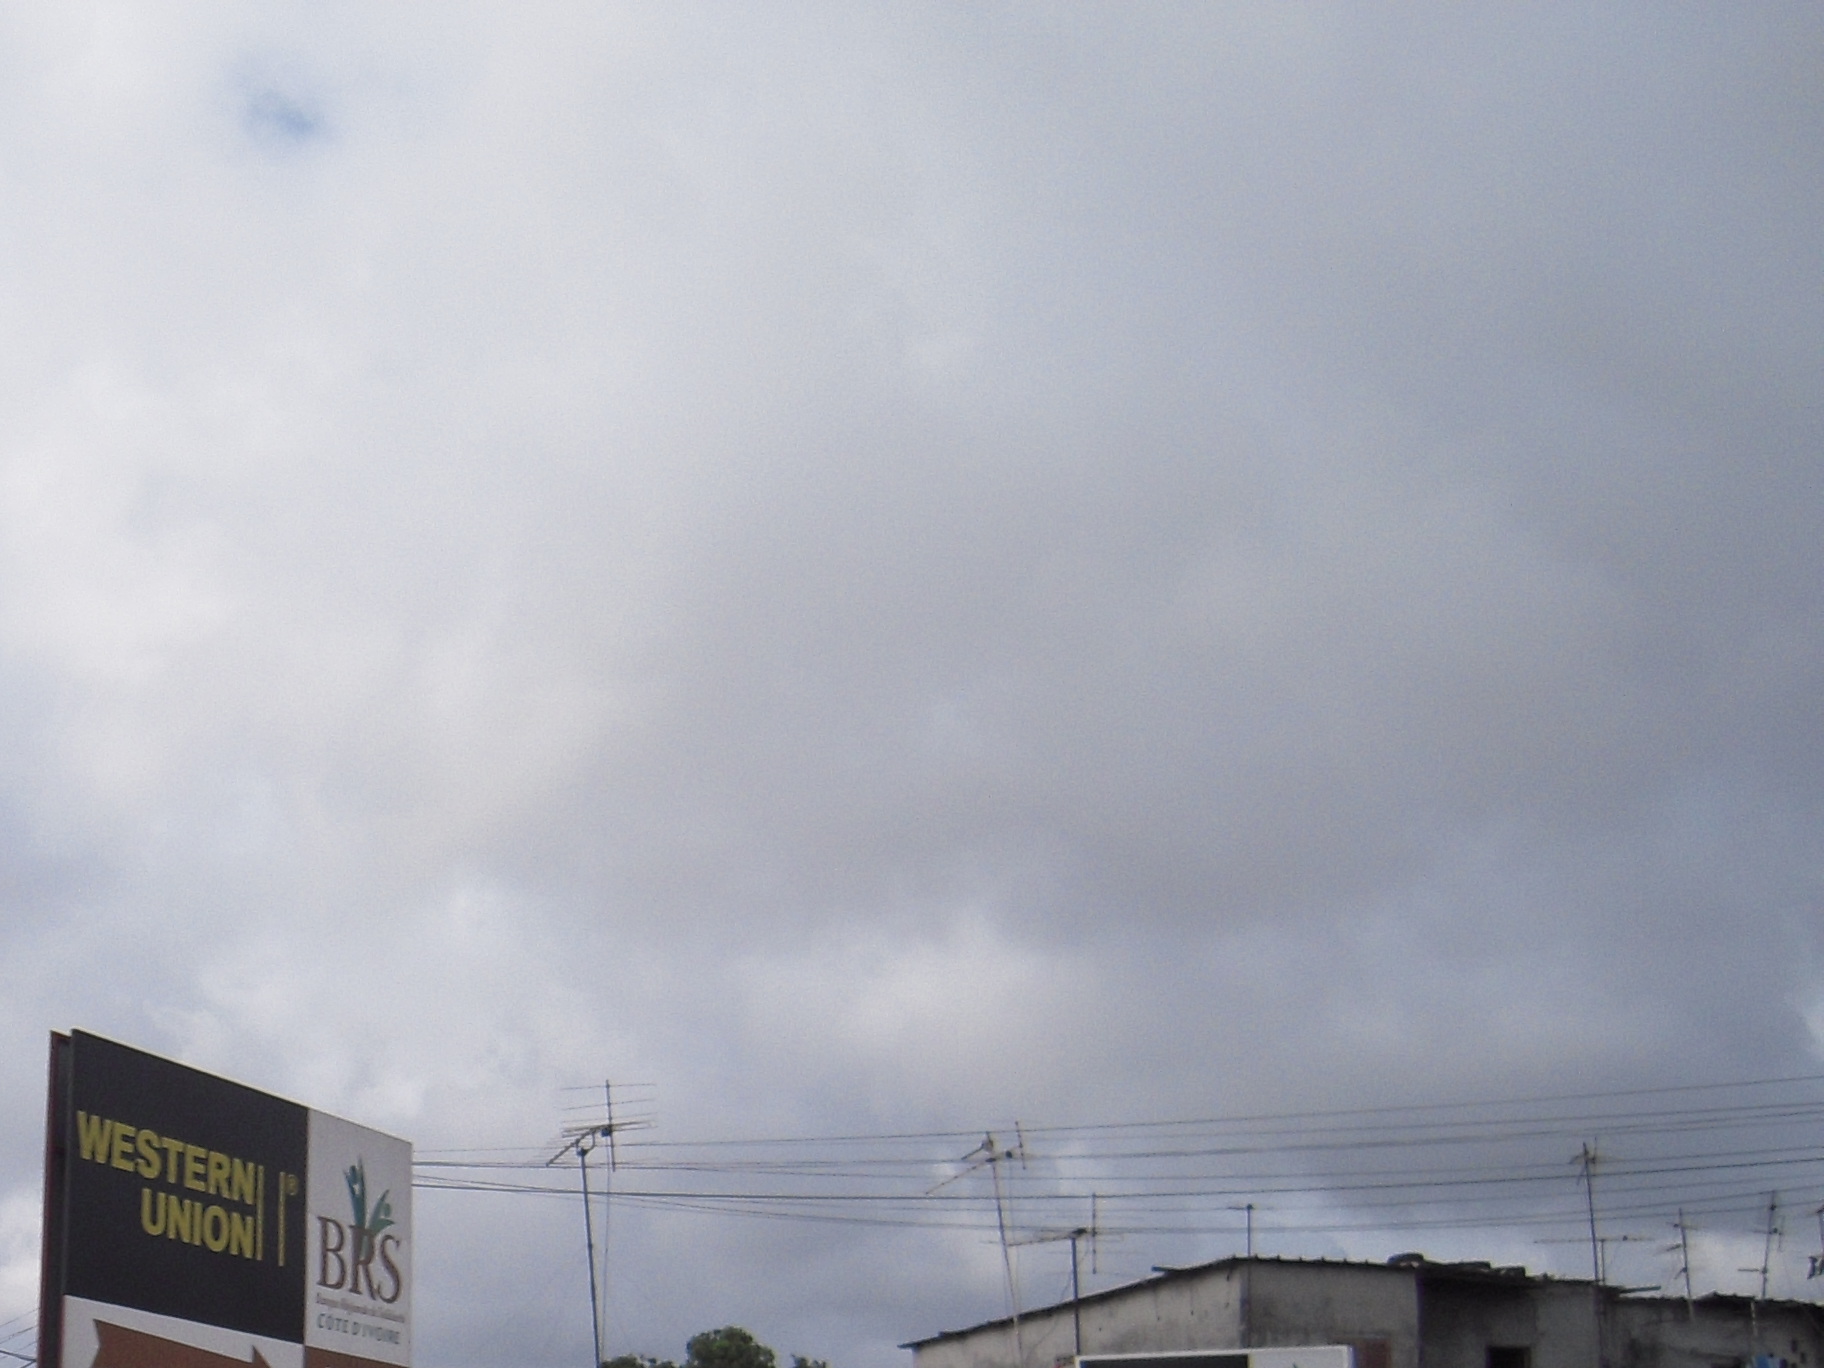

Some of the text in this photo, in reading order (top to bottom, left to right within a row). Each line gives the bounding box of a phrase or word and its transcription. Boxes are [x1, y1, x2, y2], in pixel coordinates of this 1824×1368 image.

[77, 1111, 256, 1205] WESTERN
[141, 1188, 255, 1259] UNION
[316, 1215, 402, 1304] BRS
